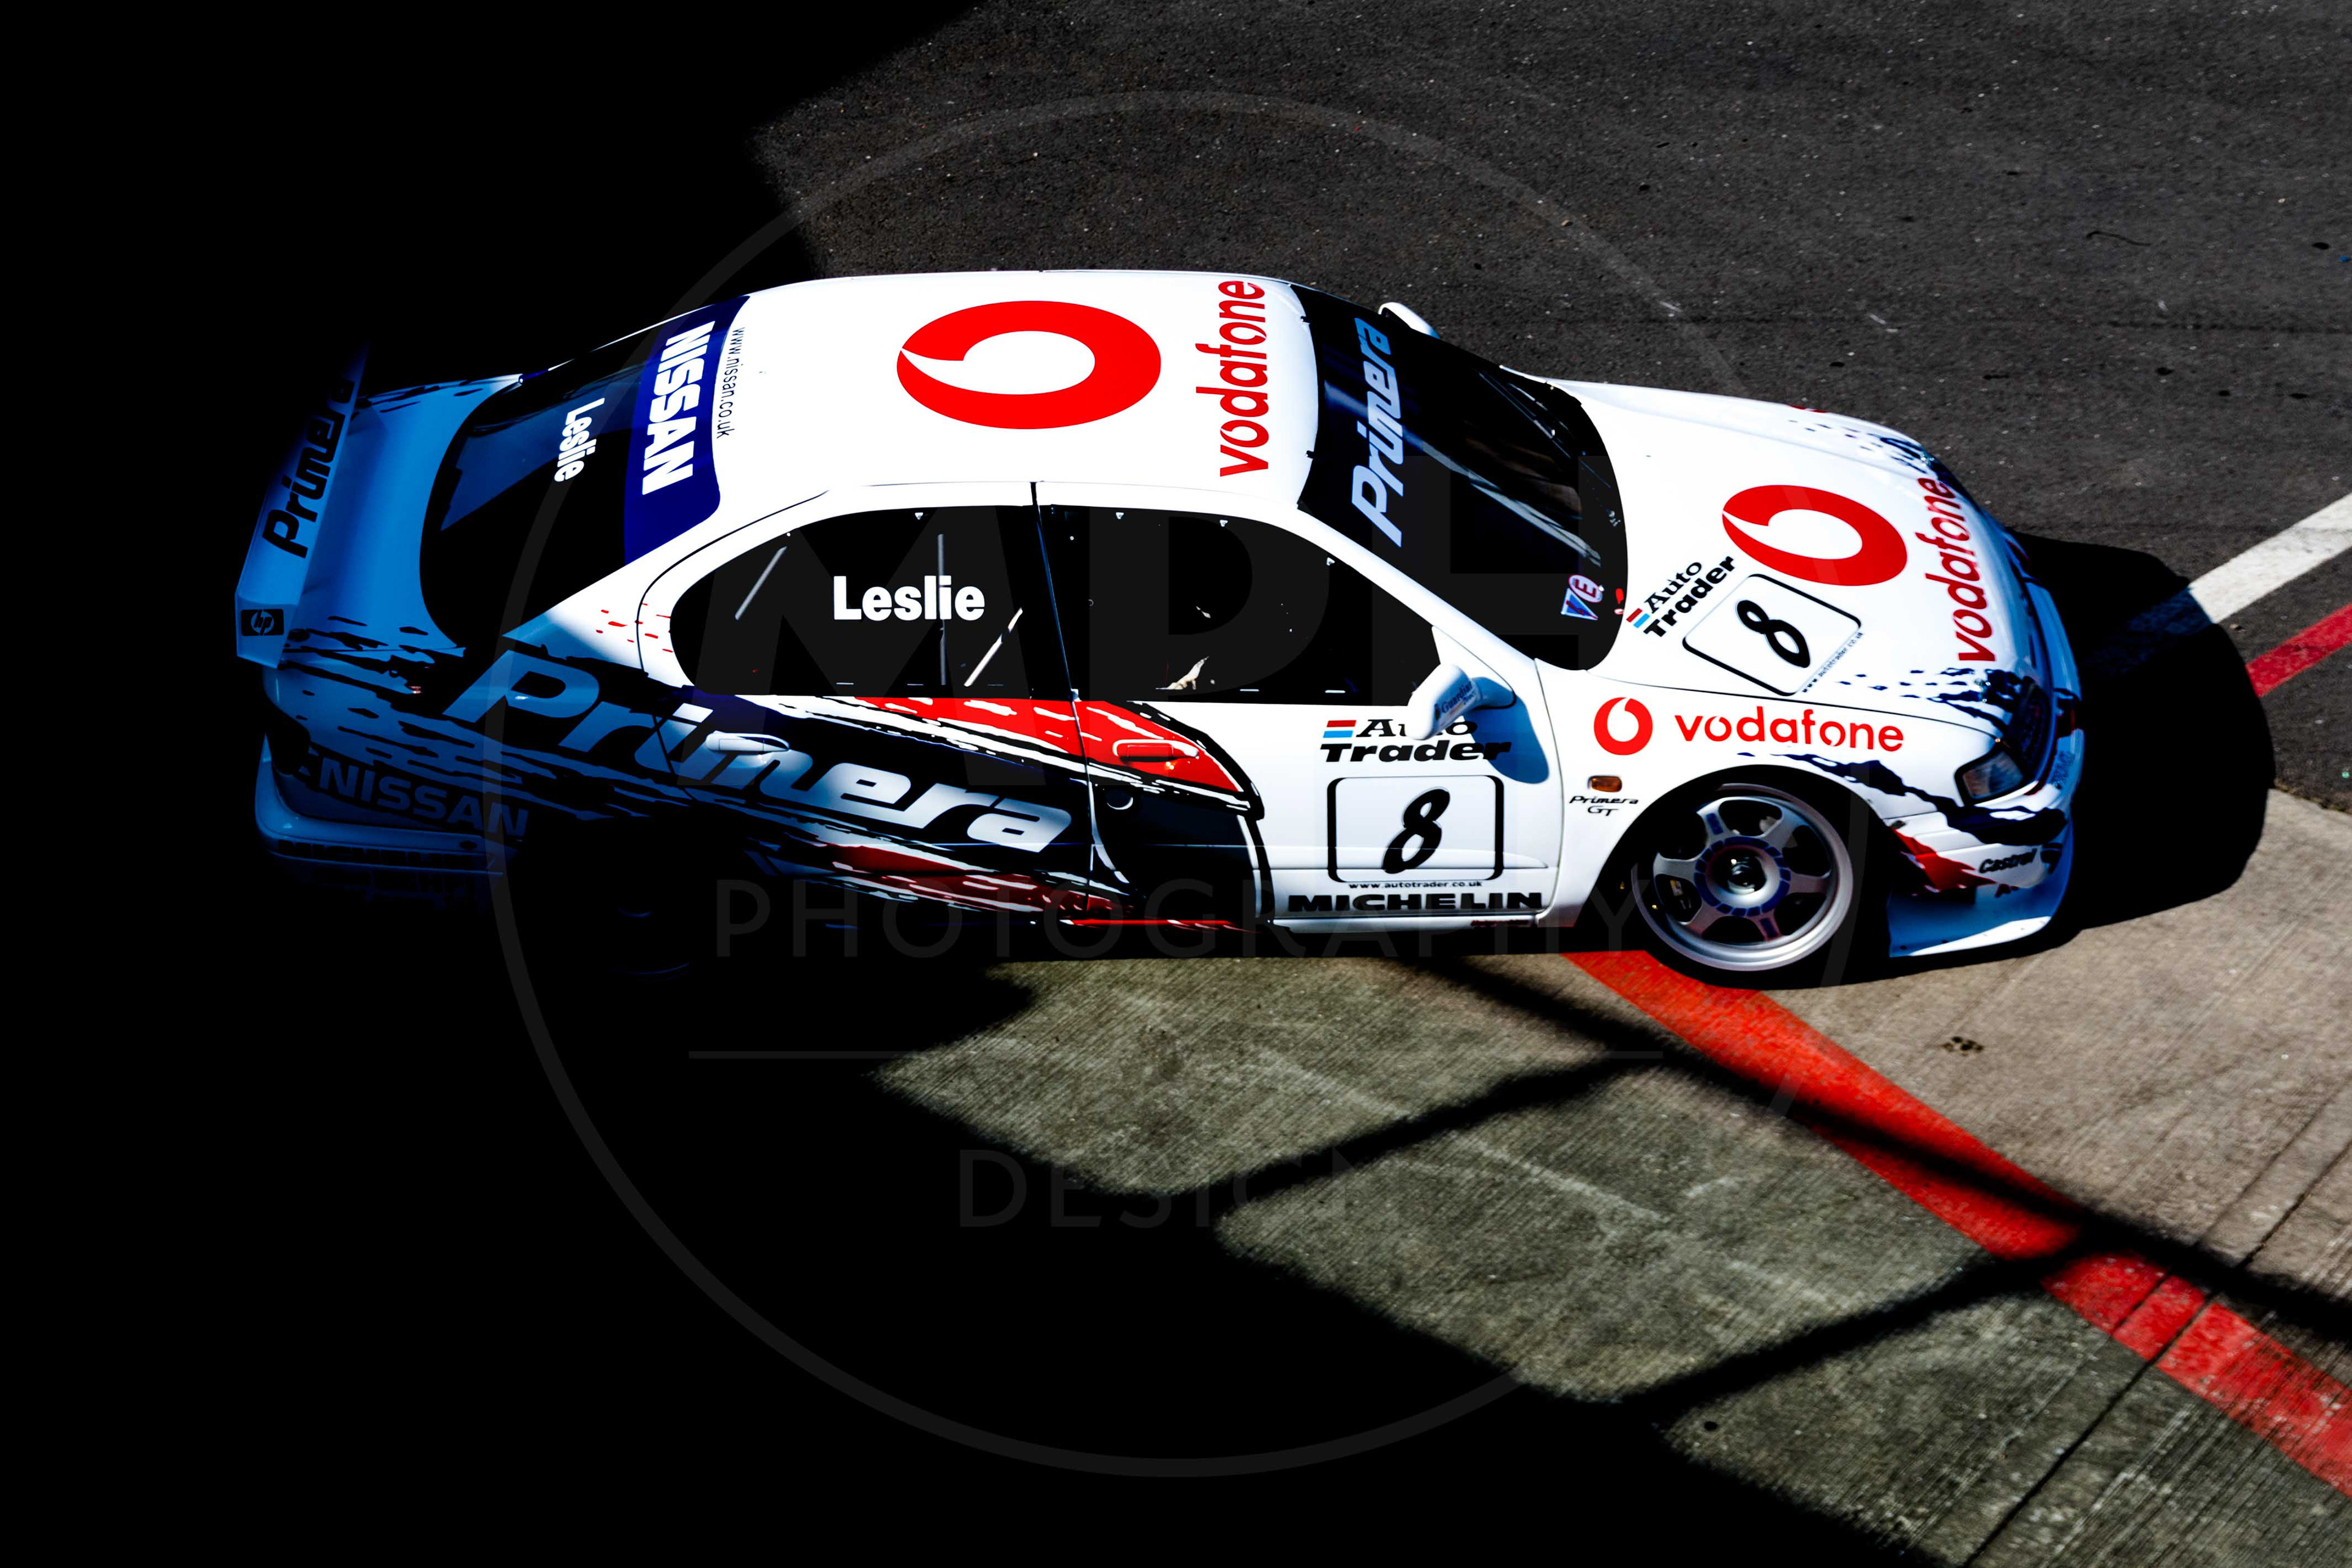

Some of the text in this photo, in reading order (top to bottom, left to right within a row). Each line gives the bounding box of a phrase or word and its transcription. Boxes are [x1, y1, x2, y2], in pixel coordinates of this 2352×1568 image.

[642, 321, 715, 495] NISSAN
[717, 326, 745, 439] www.nissan.co.uk
[1196, 281, 1268, 477] vodafone
[263, 380, 355, 558] Primera
[554, 398, 605, 483] Leslie
[1351, 317, 1404, 548] Primera
[833, 575, 986, 621] Leslie
[1644, 556, 1735, 637] Trader
[1645, 562, 1703, 611] Auto
[1916, 477, 1996, 662] vodafone
[1737, 600, 1811, 668] 8
[442, 649, 1072, 853] Primera
[1321, 740, 1511, 762] Trader
[1356, 719, 1477, 737] Ao
[1675, 706, 1903, 752] vodafone
[319, 756, 530, 839] NISSAN
[1383, 788, 1450, 873] 8
[1588, 805, 1619, 816] GT
[1289, 893, 1542, 911] MICHELIN
